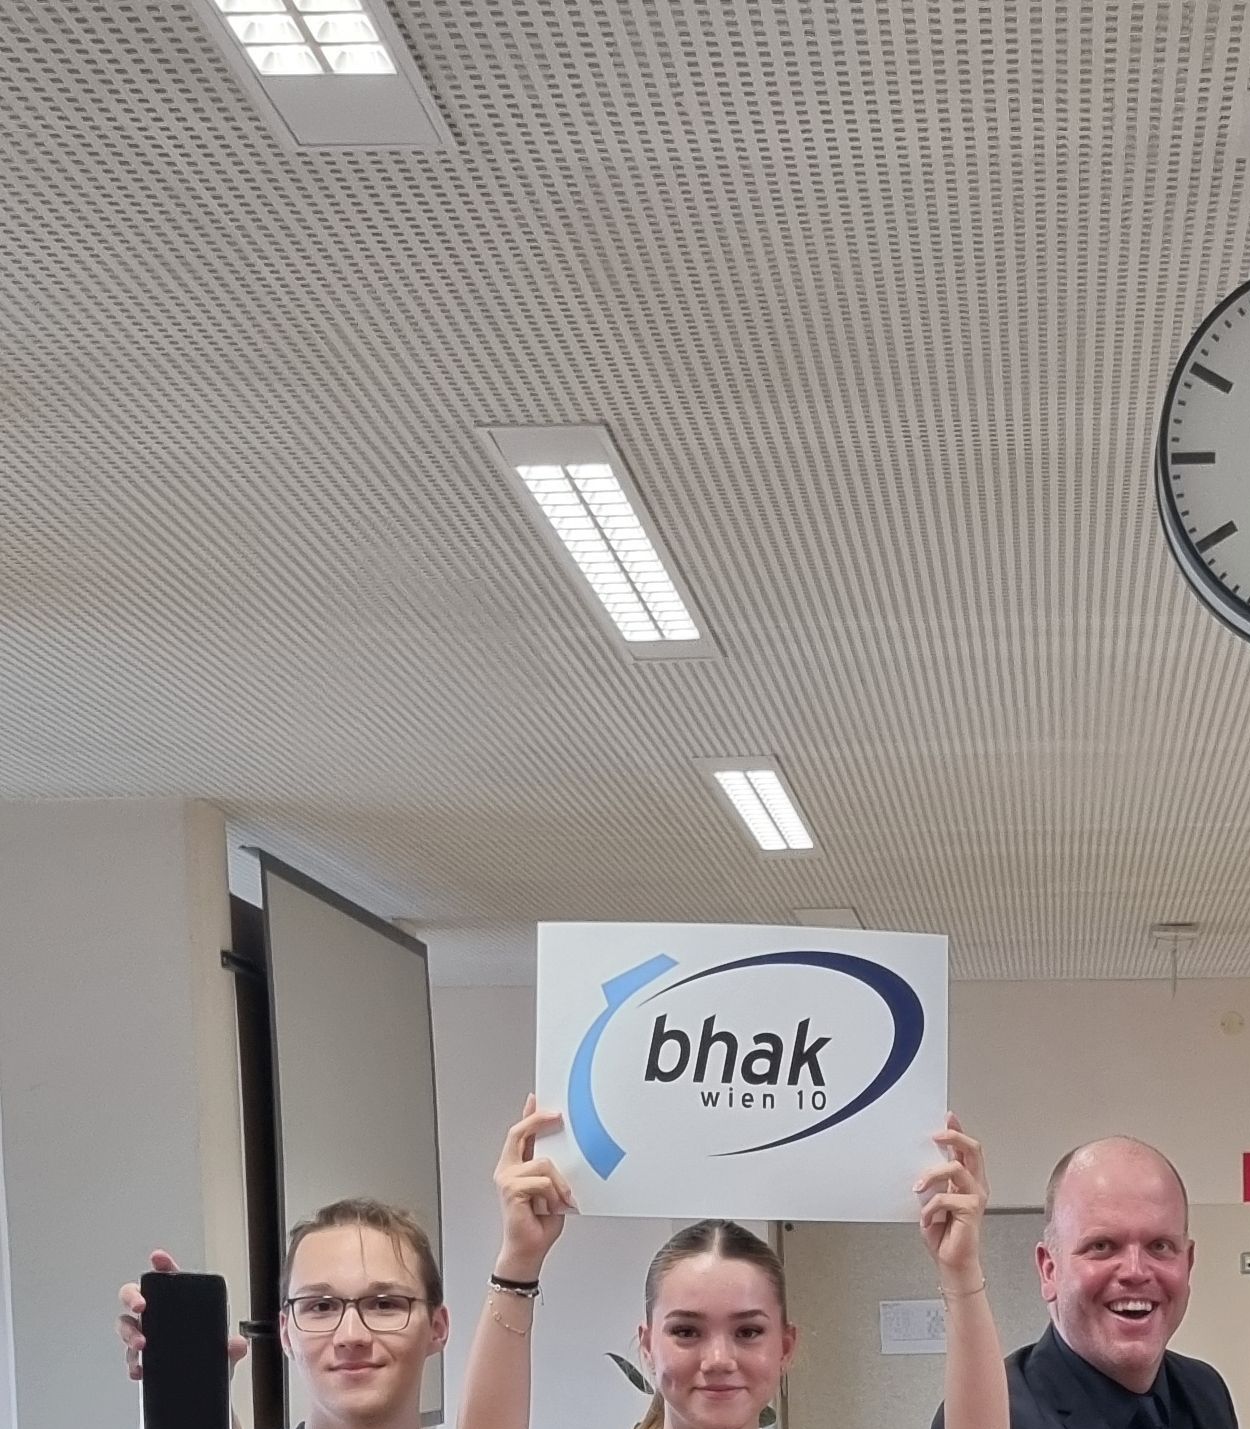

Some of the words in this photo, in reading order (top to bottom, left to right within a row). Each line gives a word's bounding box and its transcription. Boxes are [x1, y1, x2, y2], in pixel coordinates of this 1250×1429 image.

[644, 1013, 832, 1087] bhak
[700, 1087, 775, 1110] wien
[796, 1090, 827, 1111] 10
